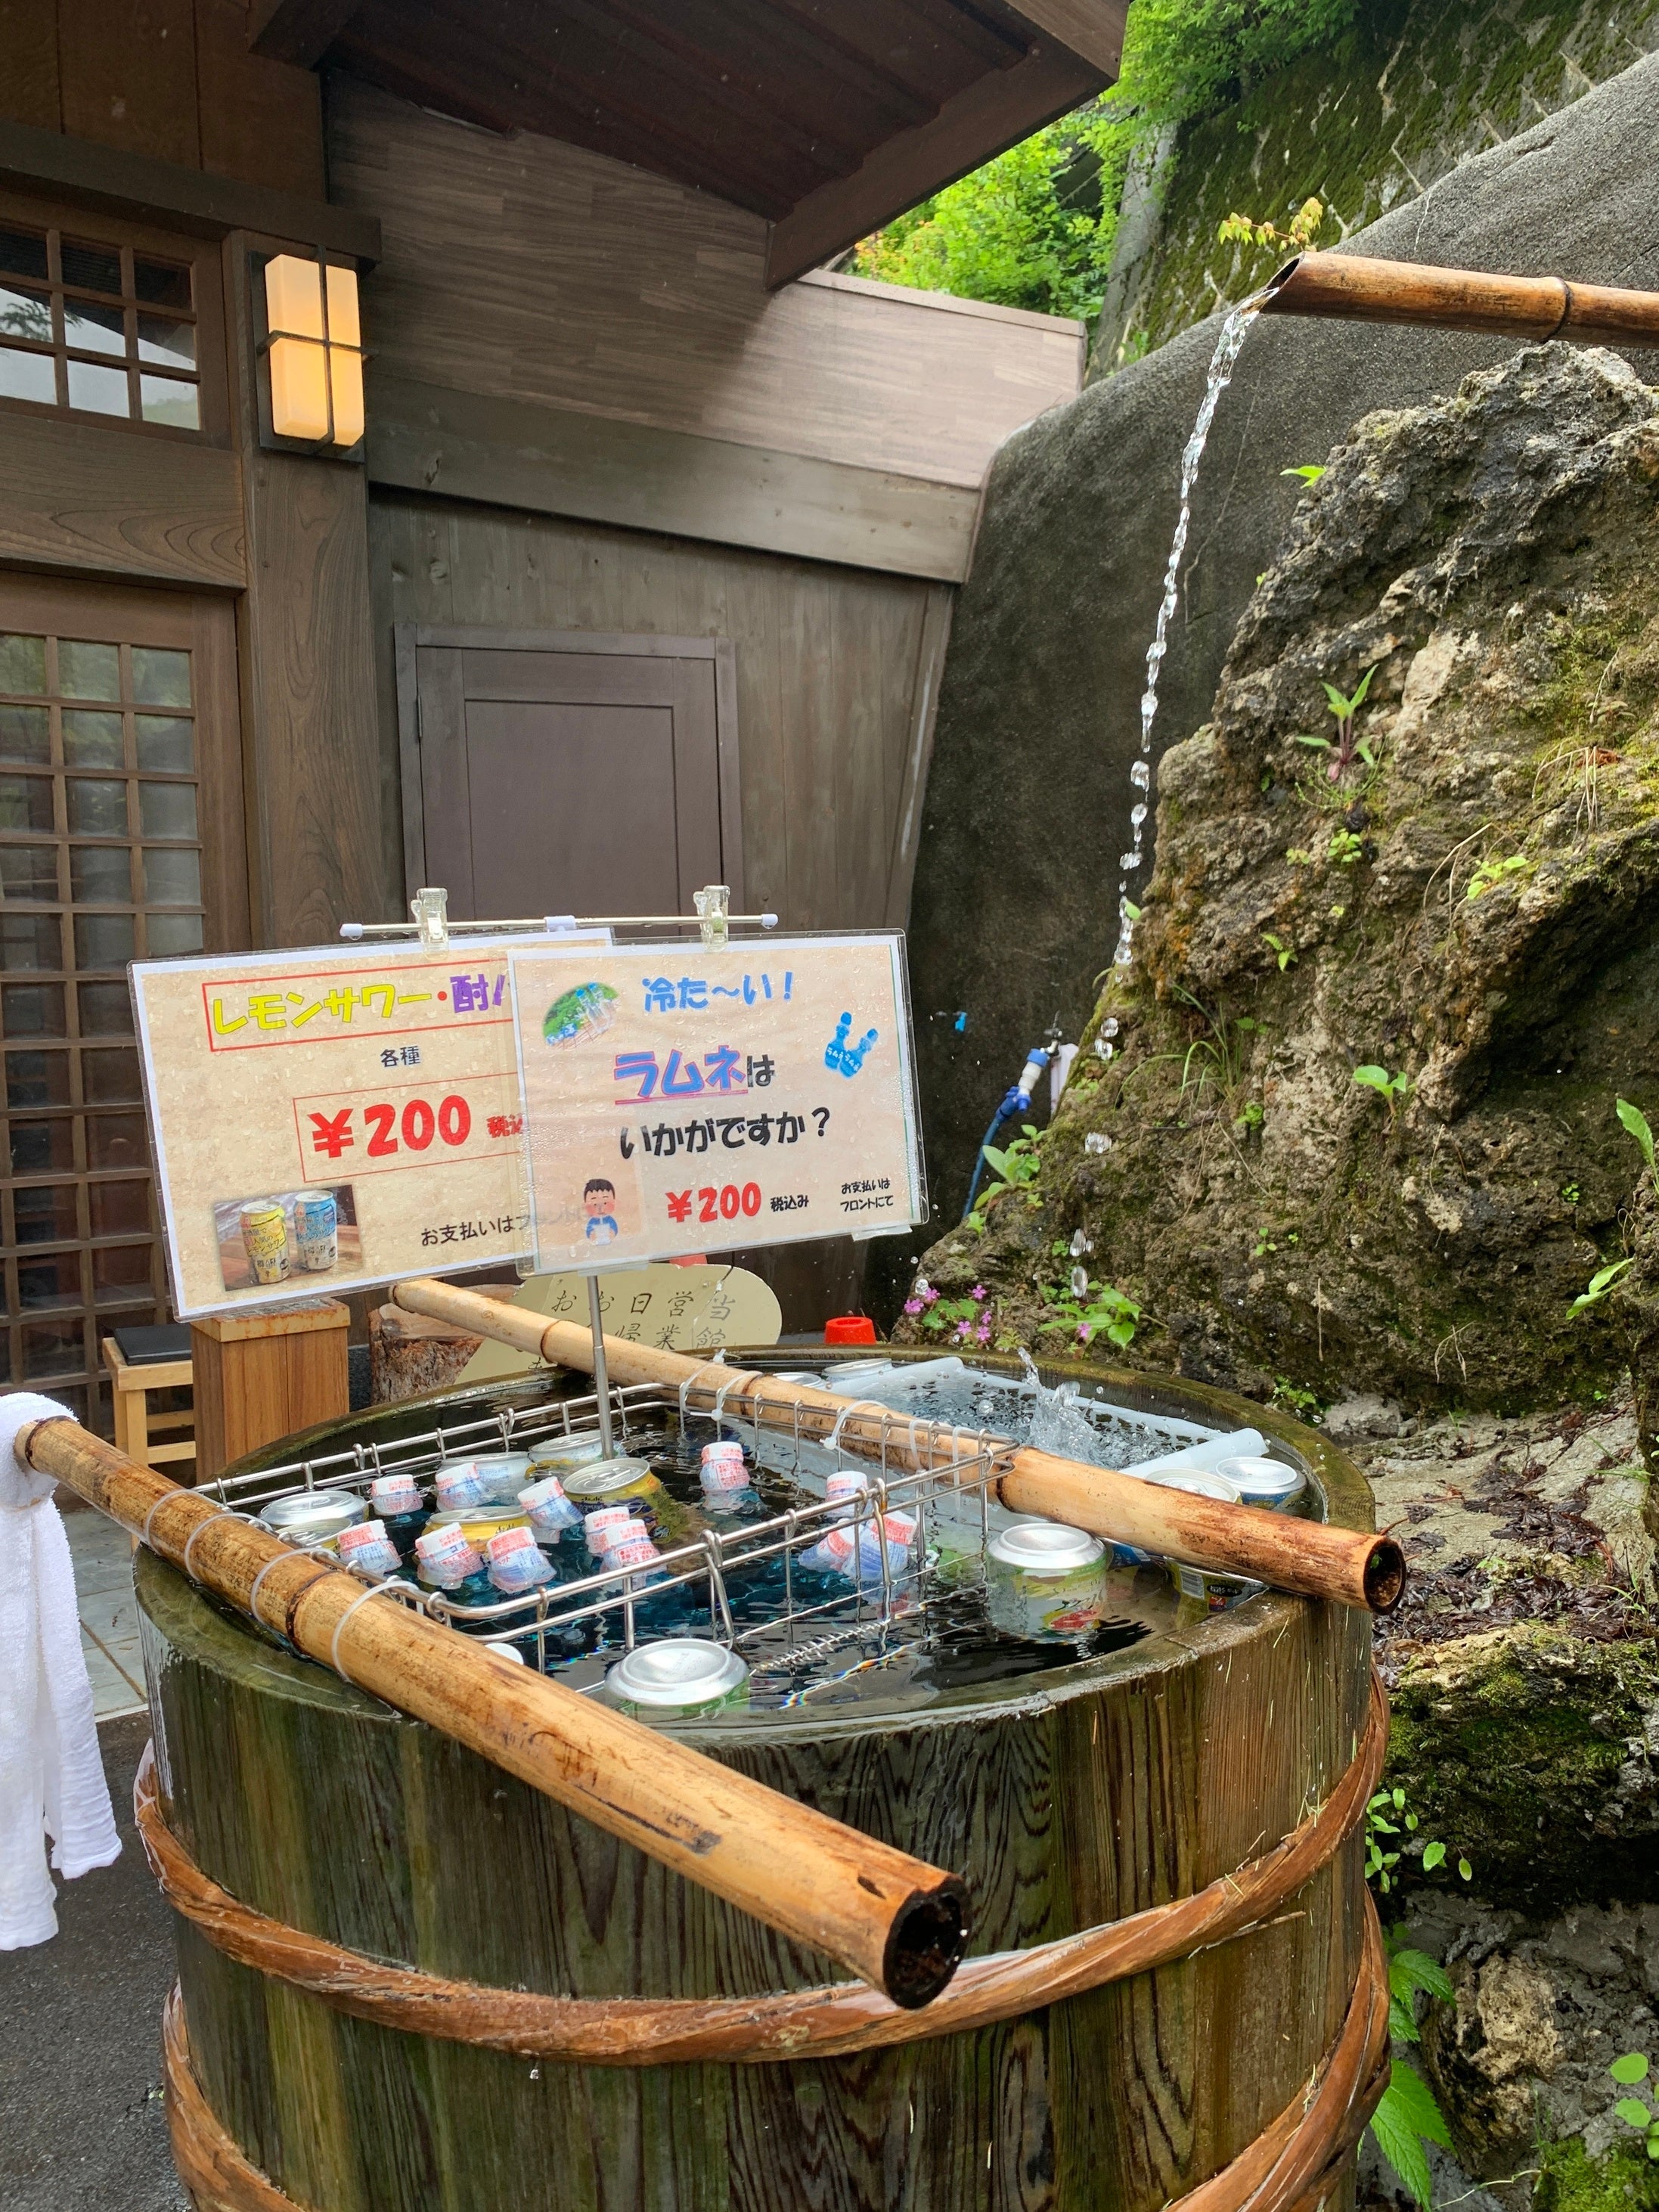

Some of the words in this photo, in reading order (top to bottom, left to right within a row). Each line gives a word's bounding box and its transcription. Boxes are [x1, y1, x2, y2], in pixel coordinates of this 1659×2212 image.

[380, 1045, 422, 1068] 各種
[614, 1044, 775, 1099] ラムネは
[308, 1094, 472, 1159] ¥200
[620, 1106, 831, 1160] いかがですか？
[665, 1182, 762, 1224] ¥200
[770, 1195, 809, 1212] 税込み
[839, 1195, 895, 1212] フロントにて
[841, 1177, 891, 1195] お支払いは
